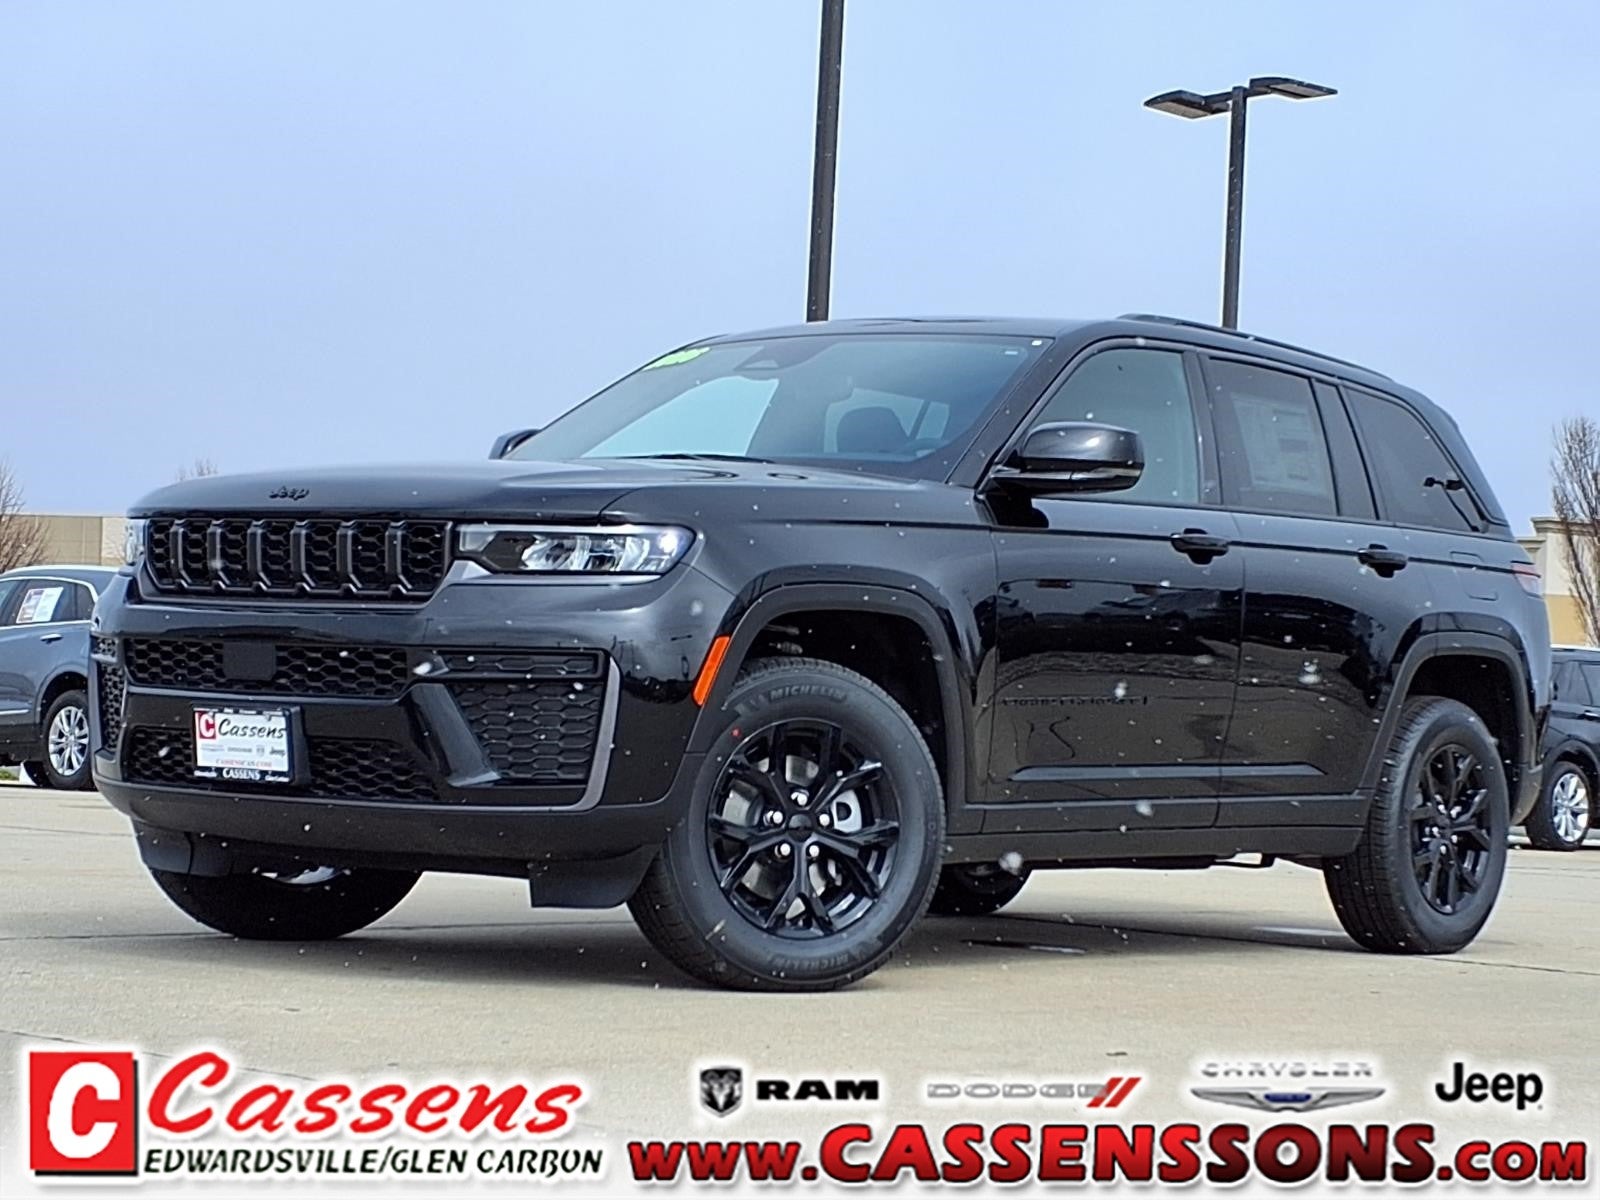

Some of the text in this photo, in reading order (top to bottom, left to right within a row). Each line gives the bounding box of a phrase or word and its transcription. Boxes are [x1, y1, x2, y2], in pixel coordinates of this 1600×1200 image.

[769, 684, 847, 702] MICHELIN
[218, 718, 286, 739] Cassens
[222, 768, 260, 780] CASSENS
